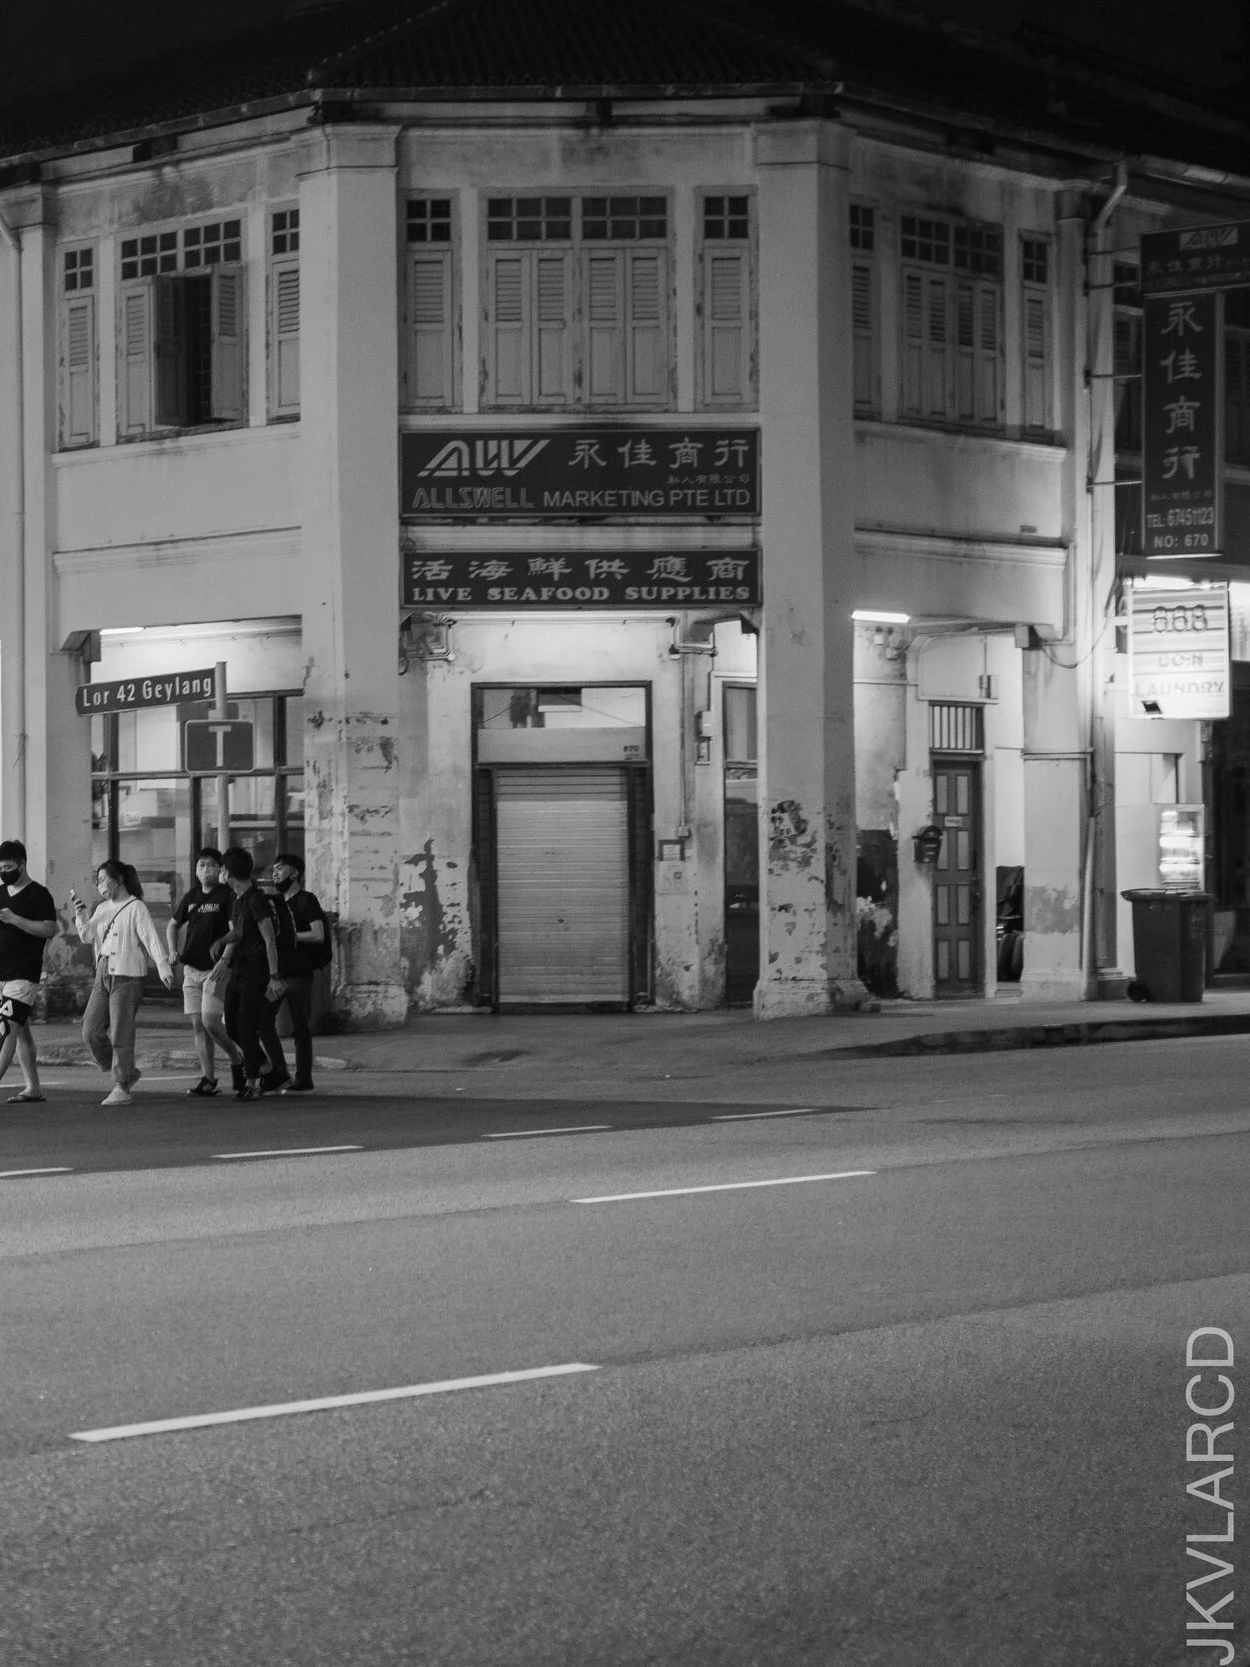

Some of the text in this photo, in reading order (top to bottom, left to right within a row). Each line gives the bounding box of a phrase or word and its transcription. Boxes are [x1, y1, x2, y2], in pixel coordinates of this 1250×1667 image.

[1160, 301, 1204, 480] 永佳商行
[568, 436, 751, 469] 永佳商行
[412, 487, 751, 510] ALLSWELL MARKETING PTE LTD
[1153, 532, 1209, 549] NO: 670
[411, 555, 751, 583] 活海鮮供應商
[412, 586, 751, 601] LIVE SEAFOOD SUPPLIES
[1153, 603, 1208, 634] 888
[82, 676, 212, 707] Lor 42 Geylang
[1134, 680, 1226, 697] LAUNDRY
